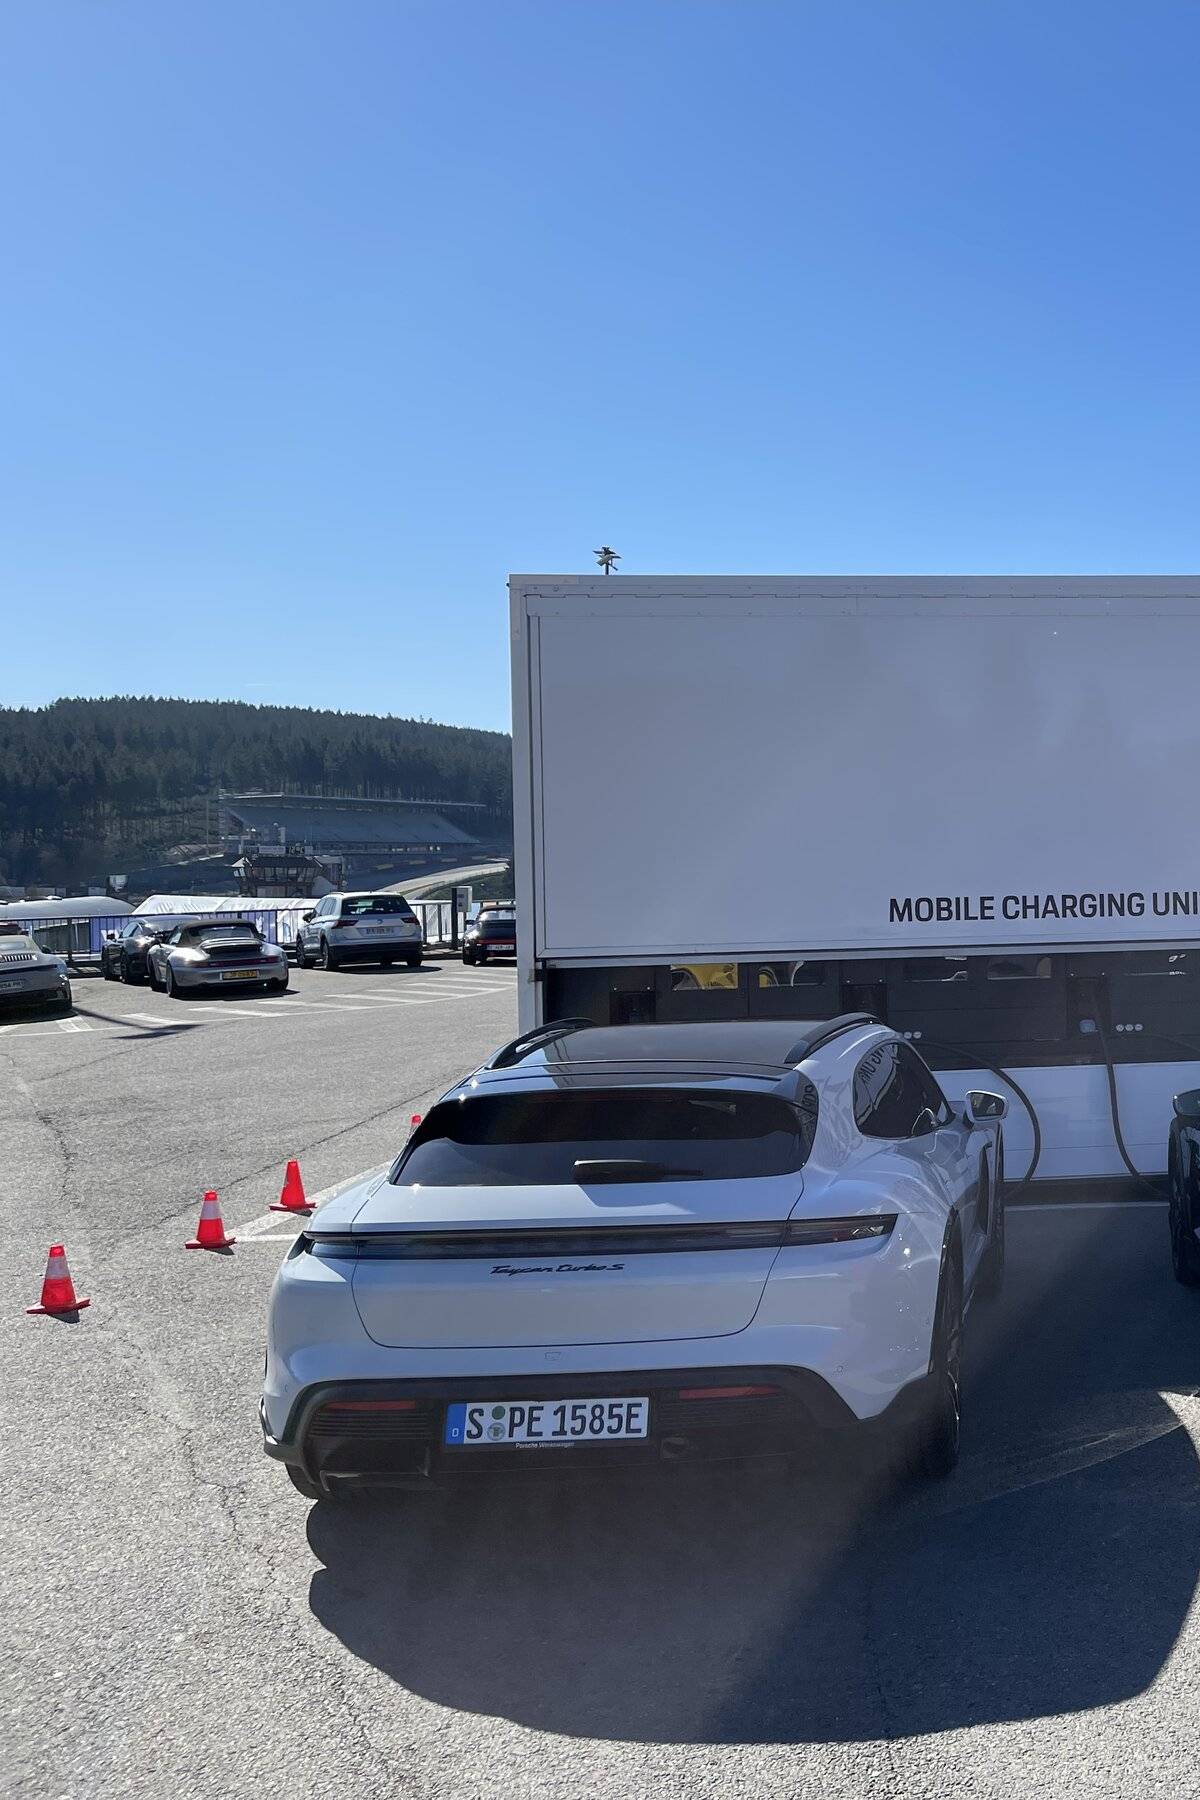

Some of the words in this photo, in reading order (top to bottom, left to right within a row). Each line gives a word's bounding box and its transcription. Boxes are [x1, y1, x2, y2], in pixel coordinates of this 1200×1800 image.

[889, 896, 995, 923] MOBILE
[1002, 892, 1145, 920] CHARGING
[489, 1264, 553, 1276] Taycan
[555, 1263, 606, 1273] Turbo
[466, 1408, 485, 1440] S
[508, 1405, 545, 1438] PE
[551, 1402, 643, 1437] 1585E
